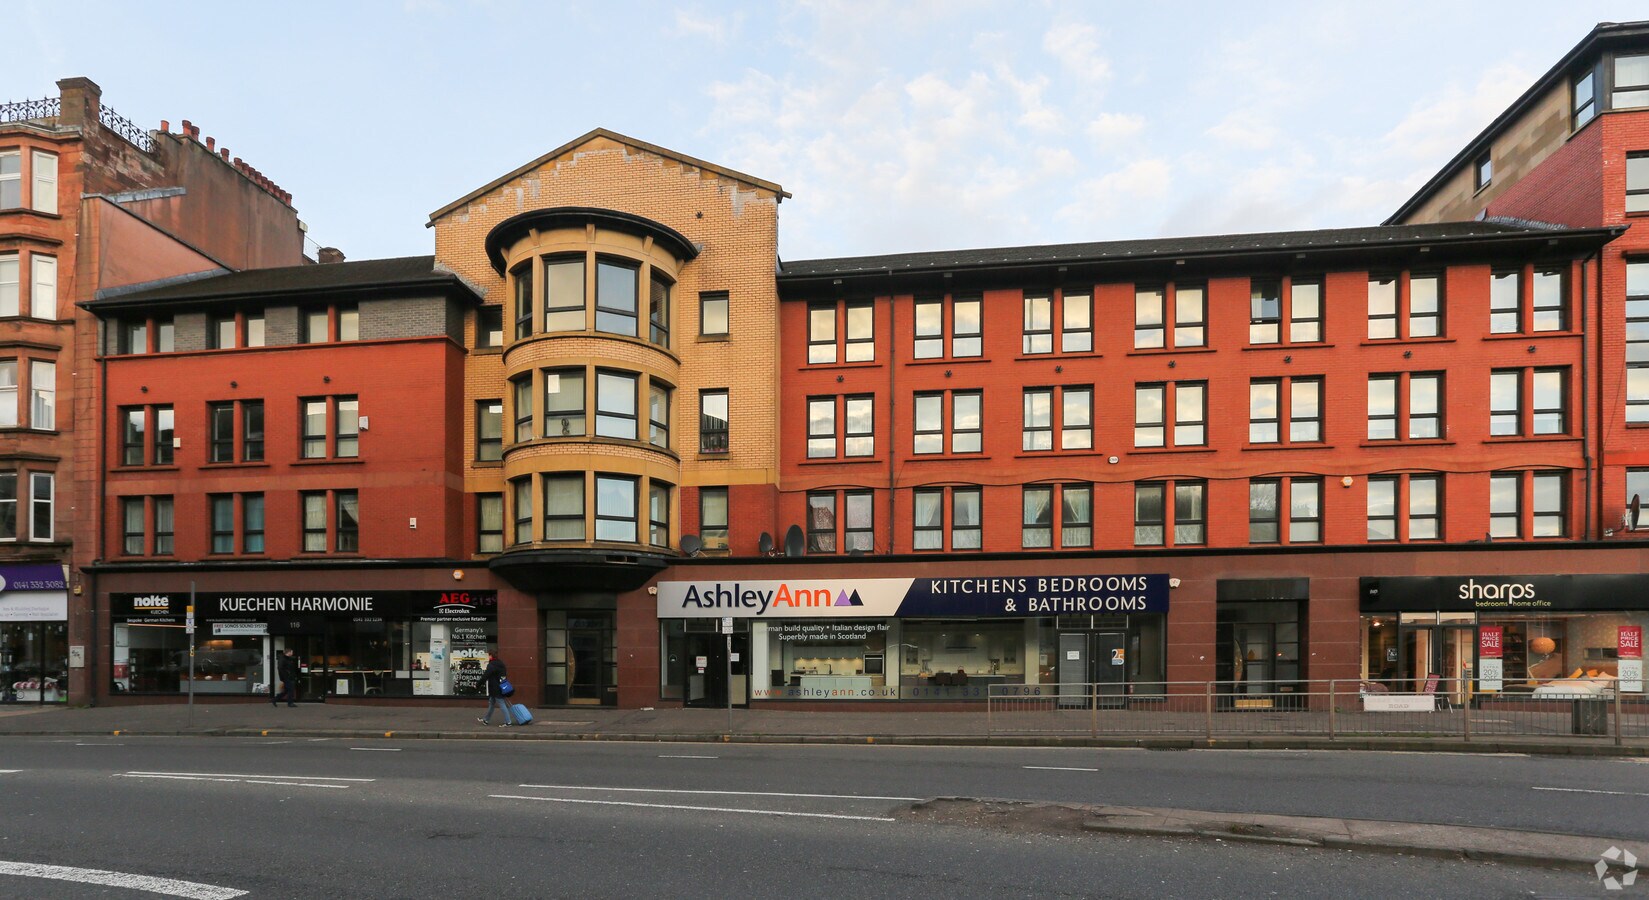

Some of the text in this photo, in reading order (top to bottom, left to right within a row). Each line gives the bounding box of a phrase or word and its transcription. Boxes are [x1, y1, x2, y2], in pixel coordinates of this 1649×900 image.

[13, 581, 29, 589] 0141
[30, 581, 44, 589] 332
[931, 576, 1148, 594] KITCHENS BEDROOMS
[1459, 578, 1536, 605] sharps
[134, 595, 169, 607] nolte
[440, 592, 471, 604] AEG
[682, 583, 832, 615] AshleyAnn
[1004, 595, 1147, 612] & BATHROOMS
[219, 597, 374, 612] KUECHEN HARMONIE
[802, 624, 825, 633] quality
[853, 624, 876, 633] design
[778, 633, 808, 641] Superbly
[1482, 640, 1500, 648] SALE
[1620, 640, 1639, 648] SALE
[453, 648, 486, 658] nolte
[754, 687, 896, 698] wwwashleyann.co.uk
[913, 687, 1040, 696] 0141 331 0796
